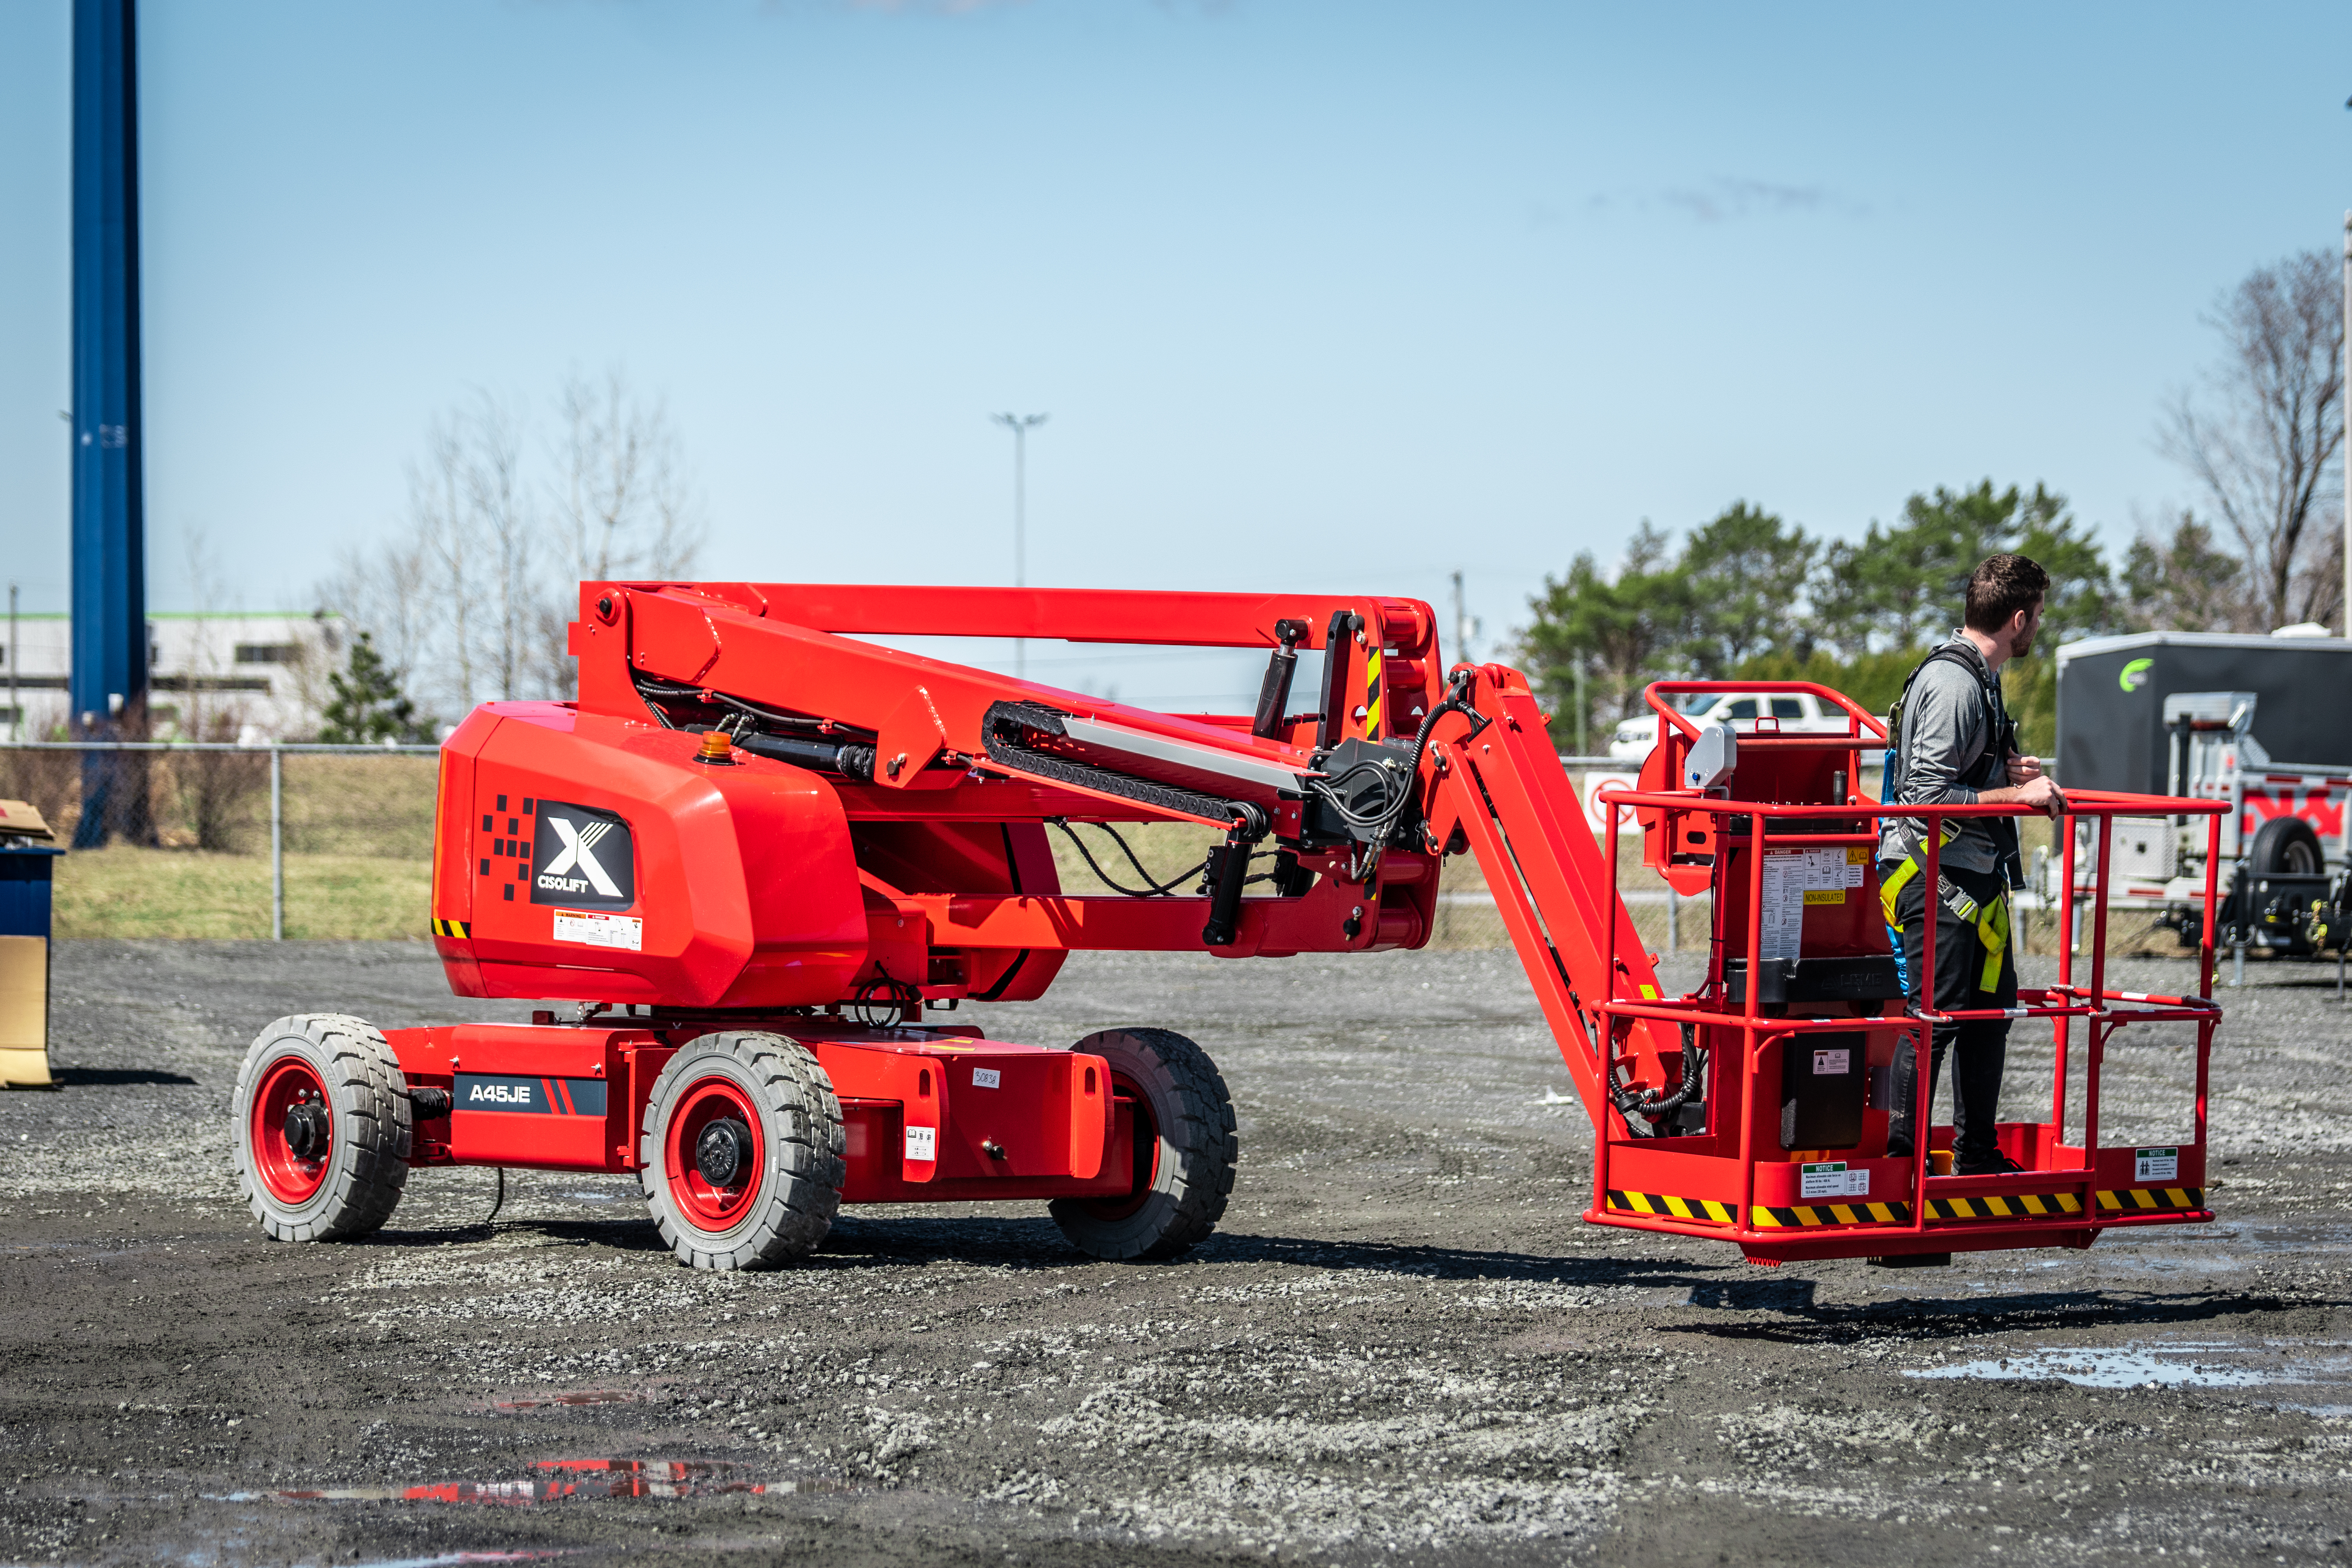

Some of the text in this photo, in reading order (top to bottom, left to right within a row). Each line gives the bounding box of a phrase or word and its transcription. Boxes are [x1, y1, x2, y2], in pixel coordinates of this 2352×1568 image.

[537, 875, 589, 893] CISOLIFT
[1806, 893, 1843, 902] NON-INSULATED
[975, 1071, 996, 1084] 30838
[469, 1084, 530, 1103] A45JE
